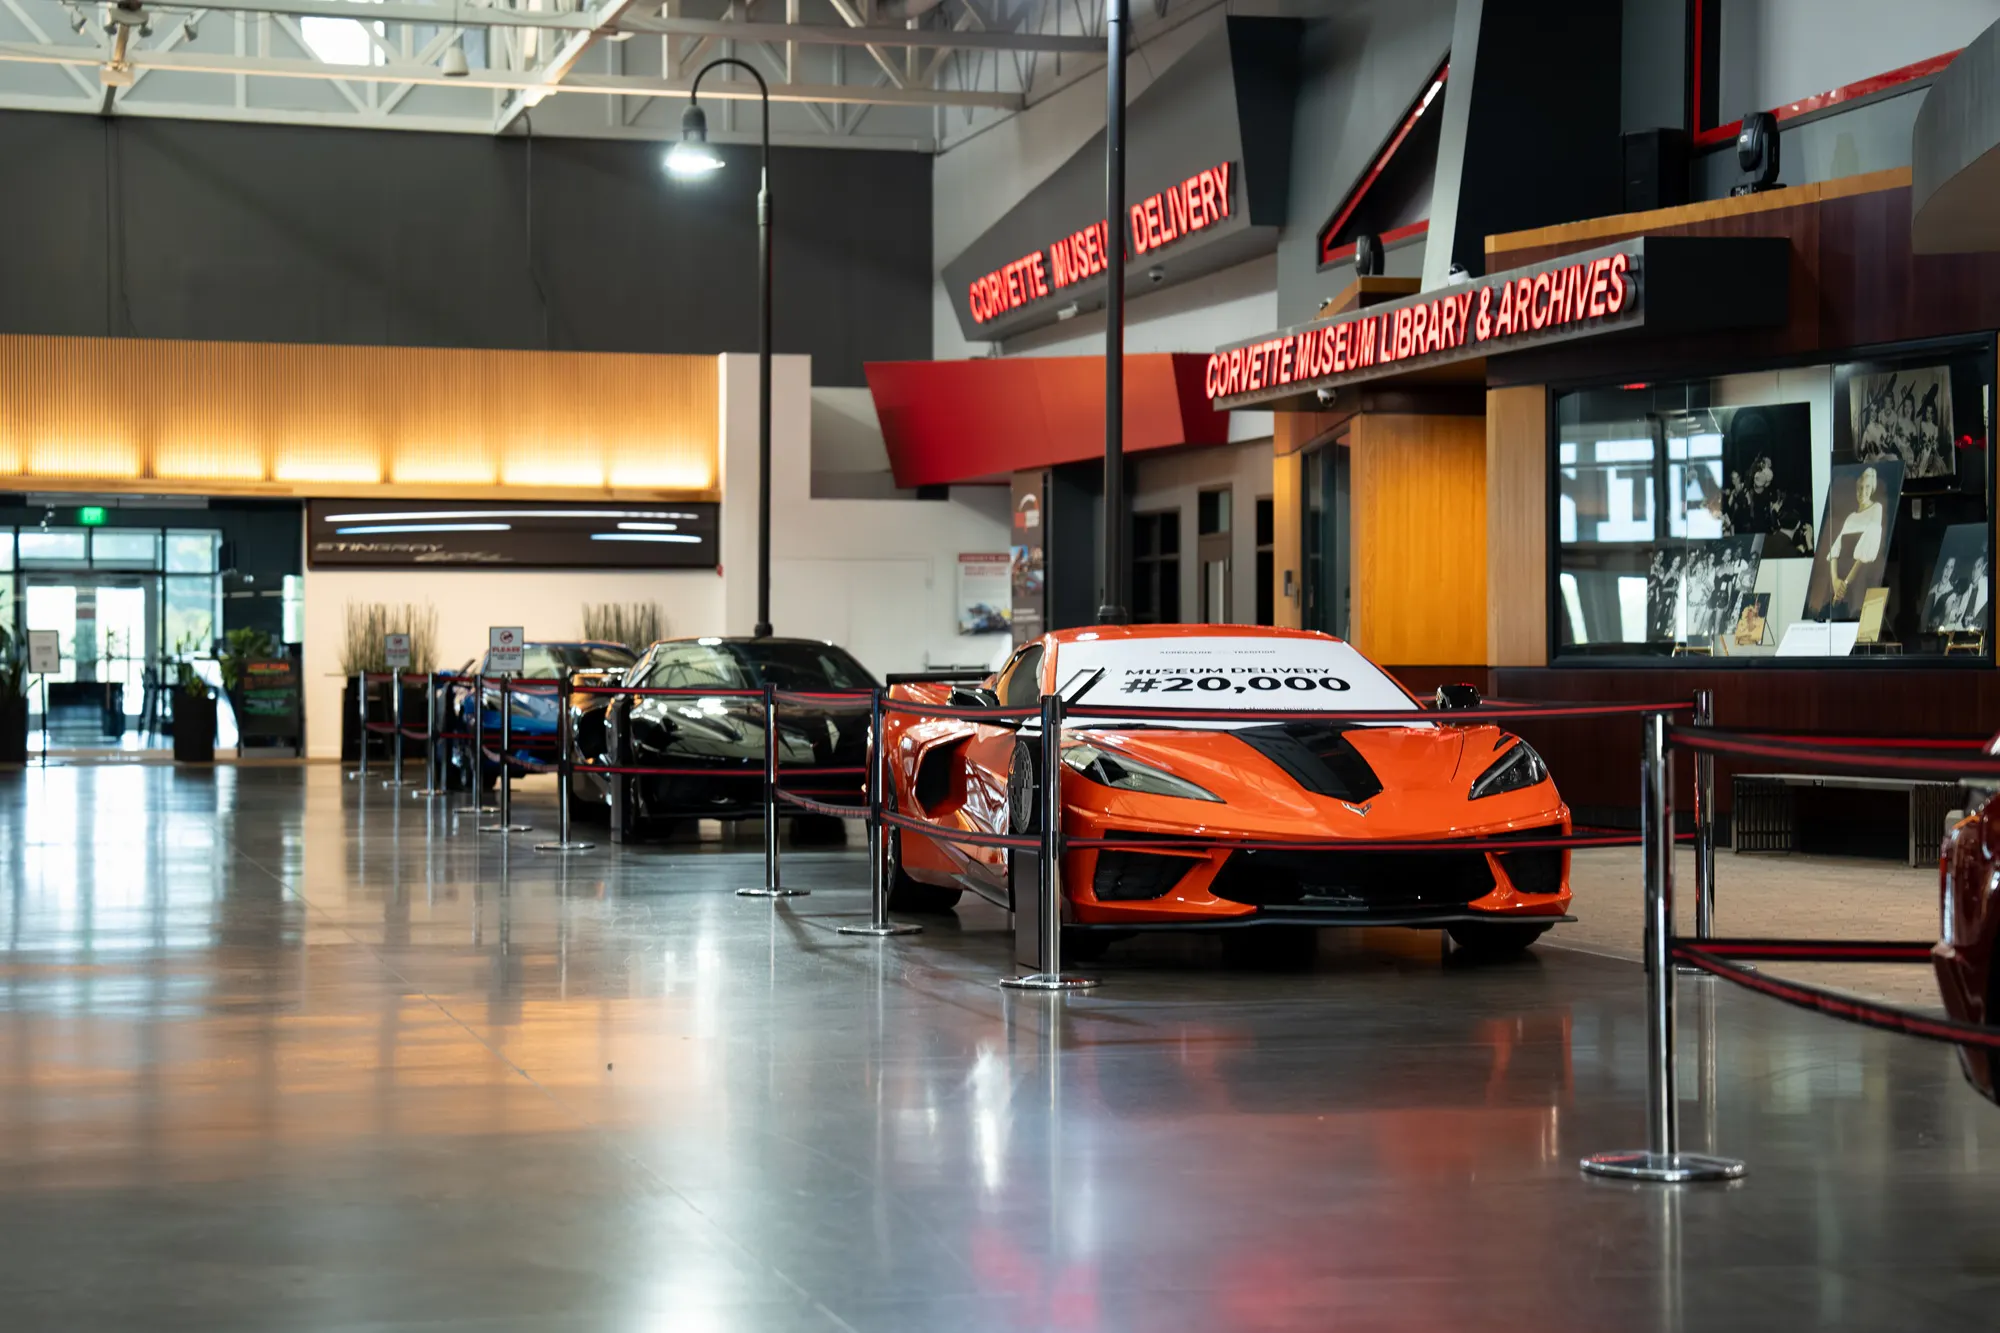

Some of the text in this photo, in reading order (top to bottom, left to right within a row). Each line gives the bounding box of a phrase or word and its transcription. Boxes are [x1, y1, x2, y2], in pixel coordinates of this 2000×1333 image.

[969, 161, 1231, 324] CORVETTE MUSEU DELIVERY
[1205, 253, 1630, 400] CORVETTE MUSEUM LIBRARY & ARCHIVES
[1119, 676, 1351, 694] #20,000
[1125, 667, 1330, 676] MUSEUM DELIVERY
